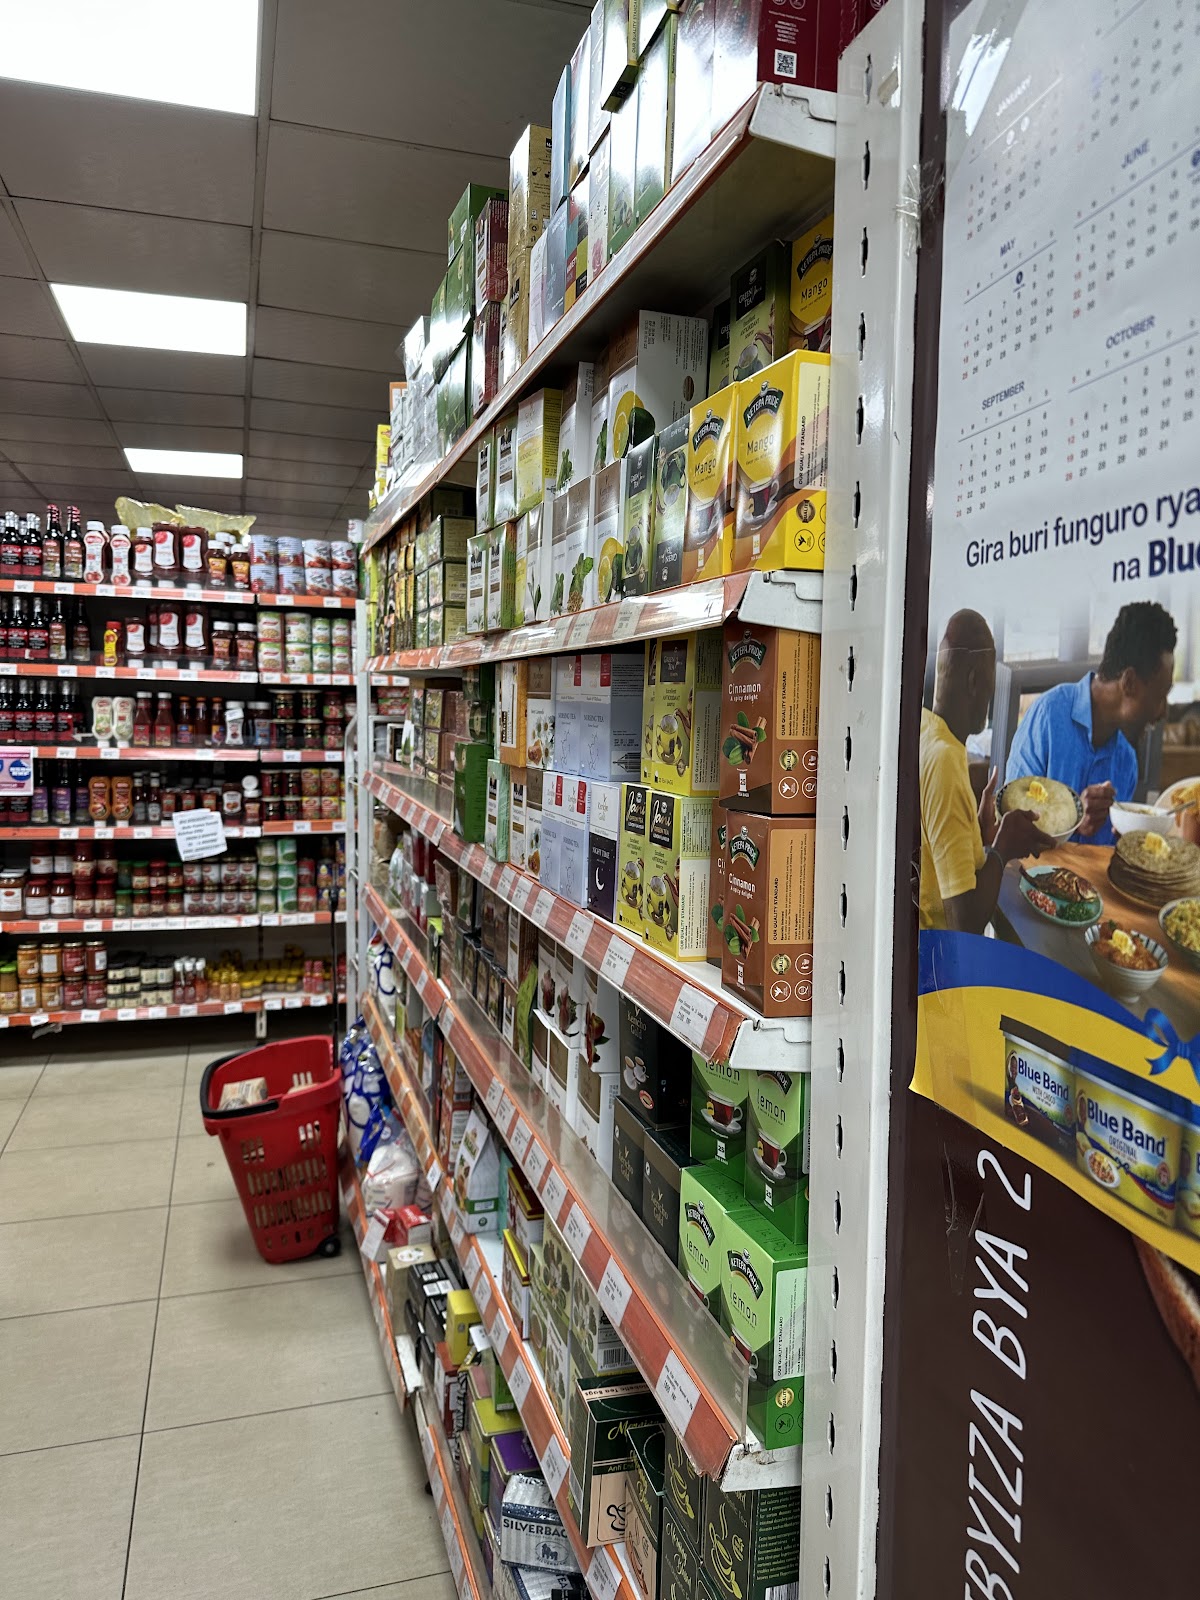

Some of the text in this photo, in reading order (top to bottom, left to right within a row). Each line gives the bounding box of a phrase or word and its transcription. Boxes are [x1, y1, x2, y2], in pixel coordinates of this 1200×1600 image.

[1000, 237, 1016, 257] MAY
[739, 289, 752, 304] GREEN
[801, 278, 828, 300] Mango
[744, 298, 753, 308] TEA
[1105, 315, 1156, 349] OCTOBER
[765, 394, 780, 409] PRIDE
[981, 381, 1025, 411] SEPTEMBER
[747, 435, 774, 455] Mango
[694, 458, 717, 478] Mango
[966, 538, 1004, 567] Gira
[1009, 521, 1049, 559] buri
[1053, 502, 1149, 546] funguro
[1113, 557, 1141, 584] na
[730, 647, 762, 663] KETEPA PRIDE
[728, 683, 761, 694] Cinnamon
[744, 693, 759, 702] delight
[650, 799, 673, 832] Jani
[728, 872, 755, 894] Cinnamon
[627, 1010, 647, 1032] Kericho
[630, 1024, 643, 1040] Gold
[705, 1061, 740, 1081] lemon
[1018, 1057, 1041, 1085] Blue
[1043, 1073, 1069, 1101] Band
[1031, 1084, 1043, 1097] WITH
[757, 1088, 786, 1122] lemon
[1087, 1098, 1119, 1134] Blue
[1122, 1116, 1166, 1158] Band
[717, 1145, 725, 1153] 25
[1108, 1134, 1137, 1159] ORIGINAL
[620, 1164, 630, 1182] Gold
[976, 1149, 1032, 1211] 2
[653, 1206, 664, 1227] Gold
[686, 1233, 710, 1271] lemon
[731, 1258, 760, 1292] KETEPA PRIDE
[730, 1283, 757, 1326] lemon
[971, 1229, 1030, 1381] BYA
[584, 1389, 603, 1398] Bags
[607, 1464, 622, 1473] Anti
[503, 1518, 568, 1539] SILVERBAC
